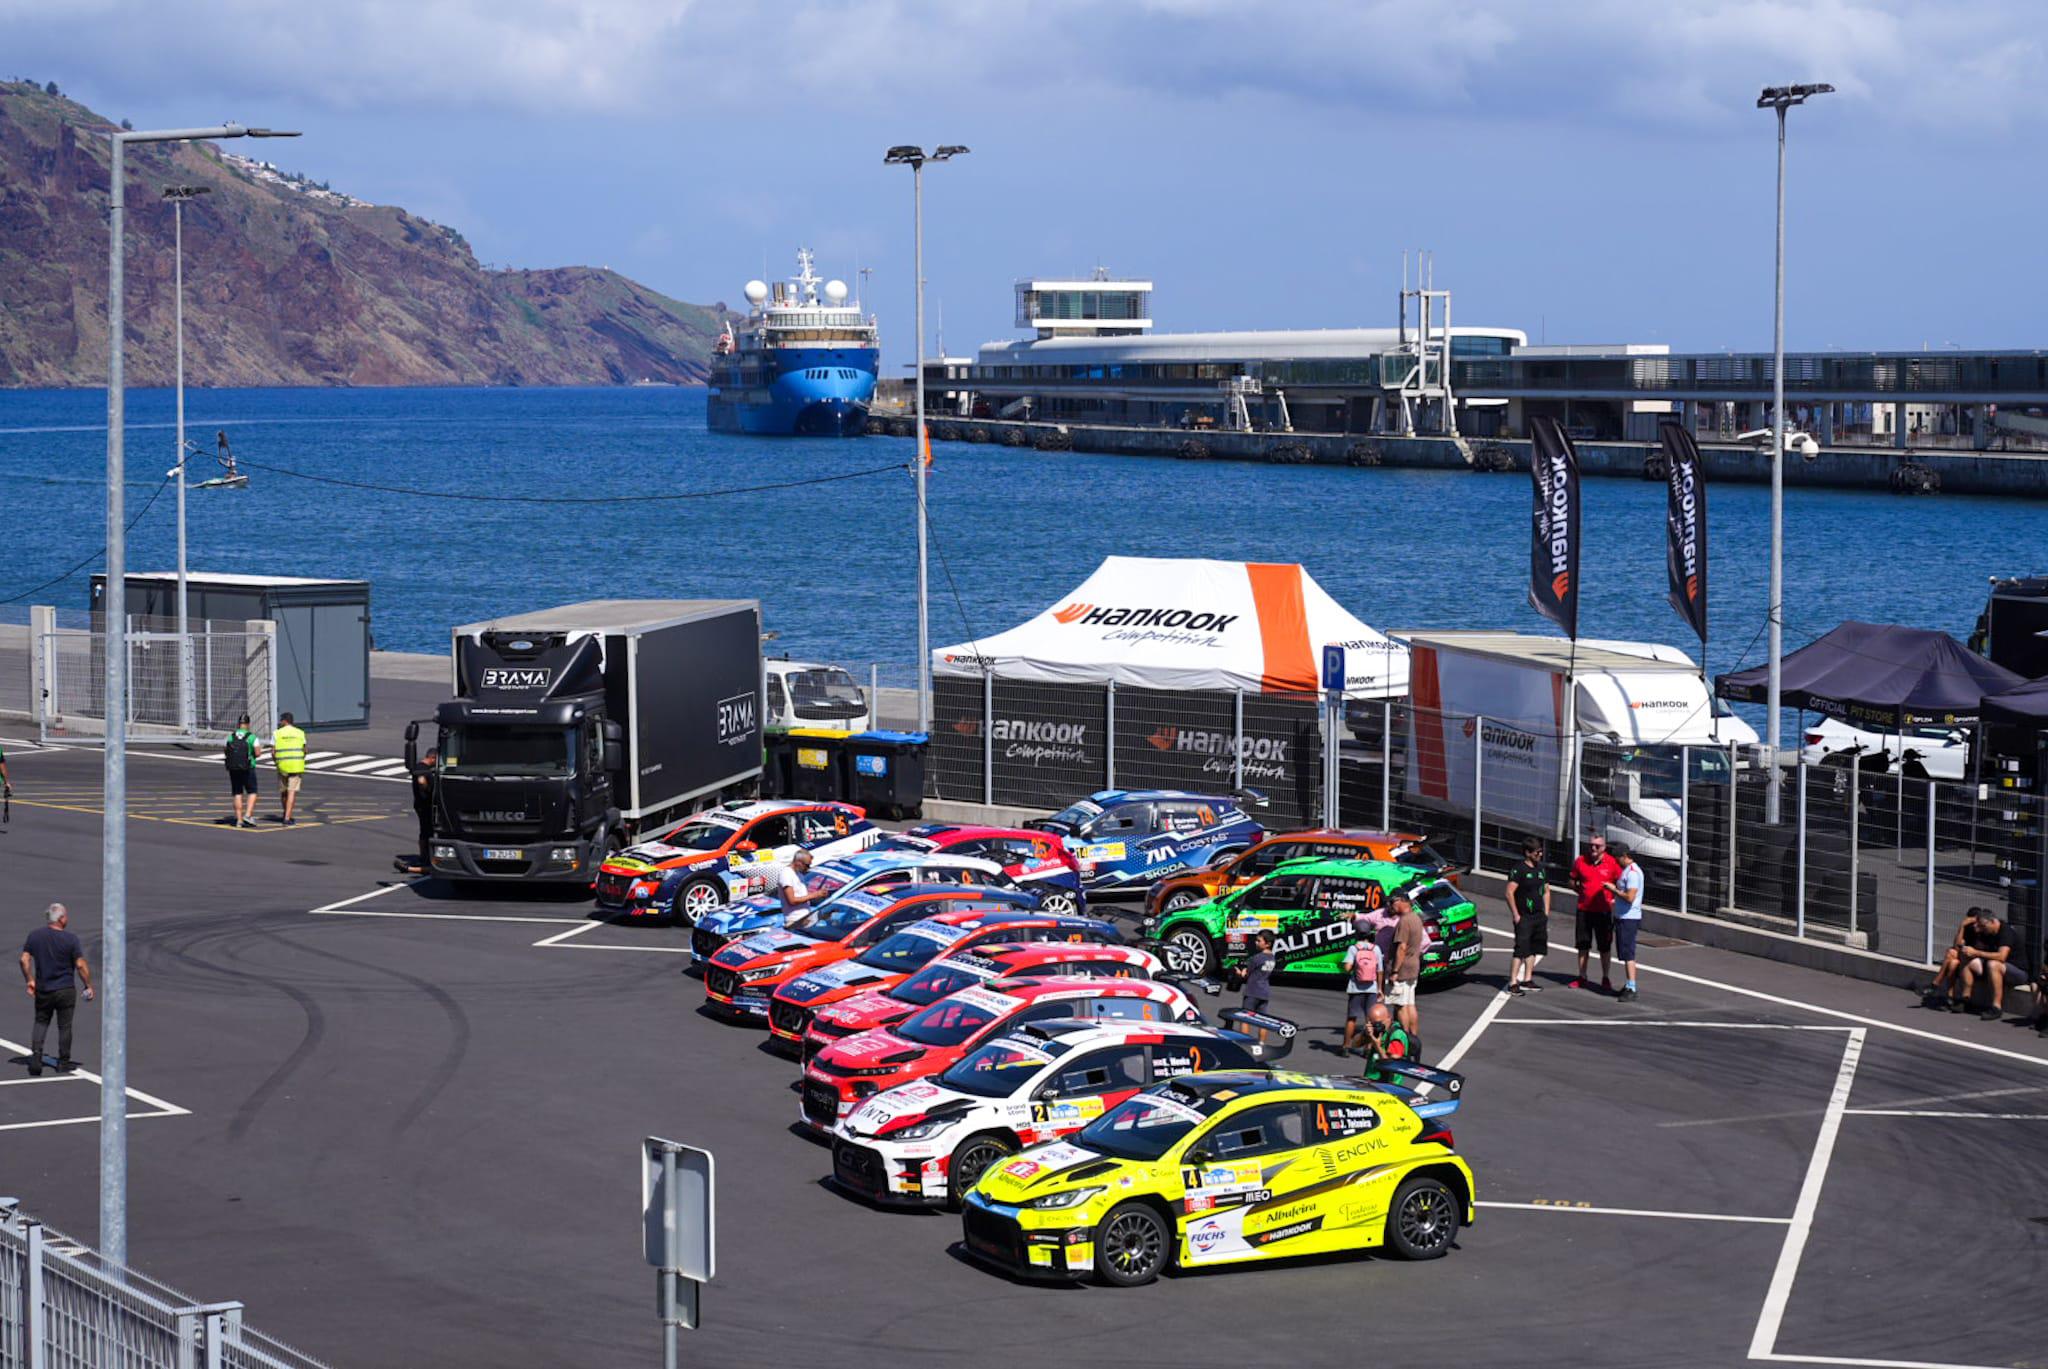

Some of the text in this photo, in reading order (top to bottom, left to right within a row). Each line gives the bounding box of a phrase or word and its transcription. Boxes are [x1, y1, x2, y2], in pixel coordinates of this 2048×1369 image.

[1085, 606, 1239, 632] HANKOOK
[1101, 628, 1225, 648] Competition
[486, 671, 545, 684] BRAMA
[1327, 650, 1341, 686] P
[719, 700, 755, 737] BRAMA
[1809, 697, 1895, 723] OFFICIAL PIT STORE
[980, 718, 1086, 745] ANKOOK
[479, 811, 525, 822] IVECO
[1197, 806, 1215, 826] 14
[1365, 886, 1381, 909] 16
[1189, 1046, 1204, 1074] 2
[1034, 1104, 1045, 1122] 2
[1317, 1103, 1329, 1136] 4
[1336, 1137, 1389, 1162] ENCIVIL
[1188, 1169, 1198, 1188] 4
[1266, 1203, 1317, 1223] Albufeira
[1190, 1231, 1226, 1243] FUCHS
